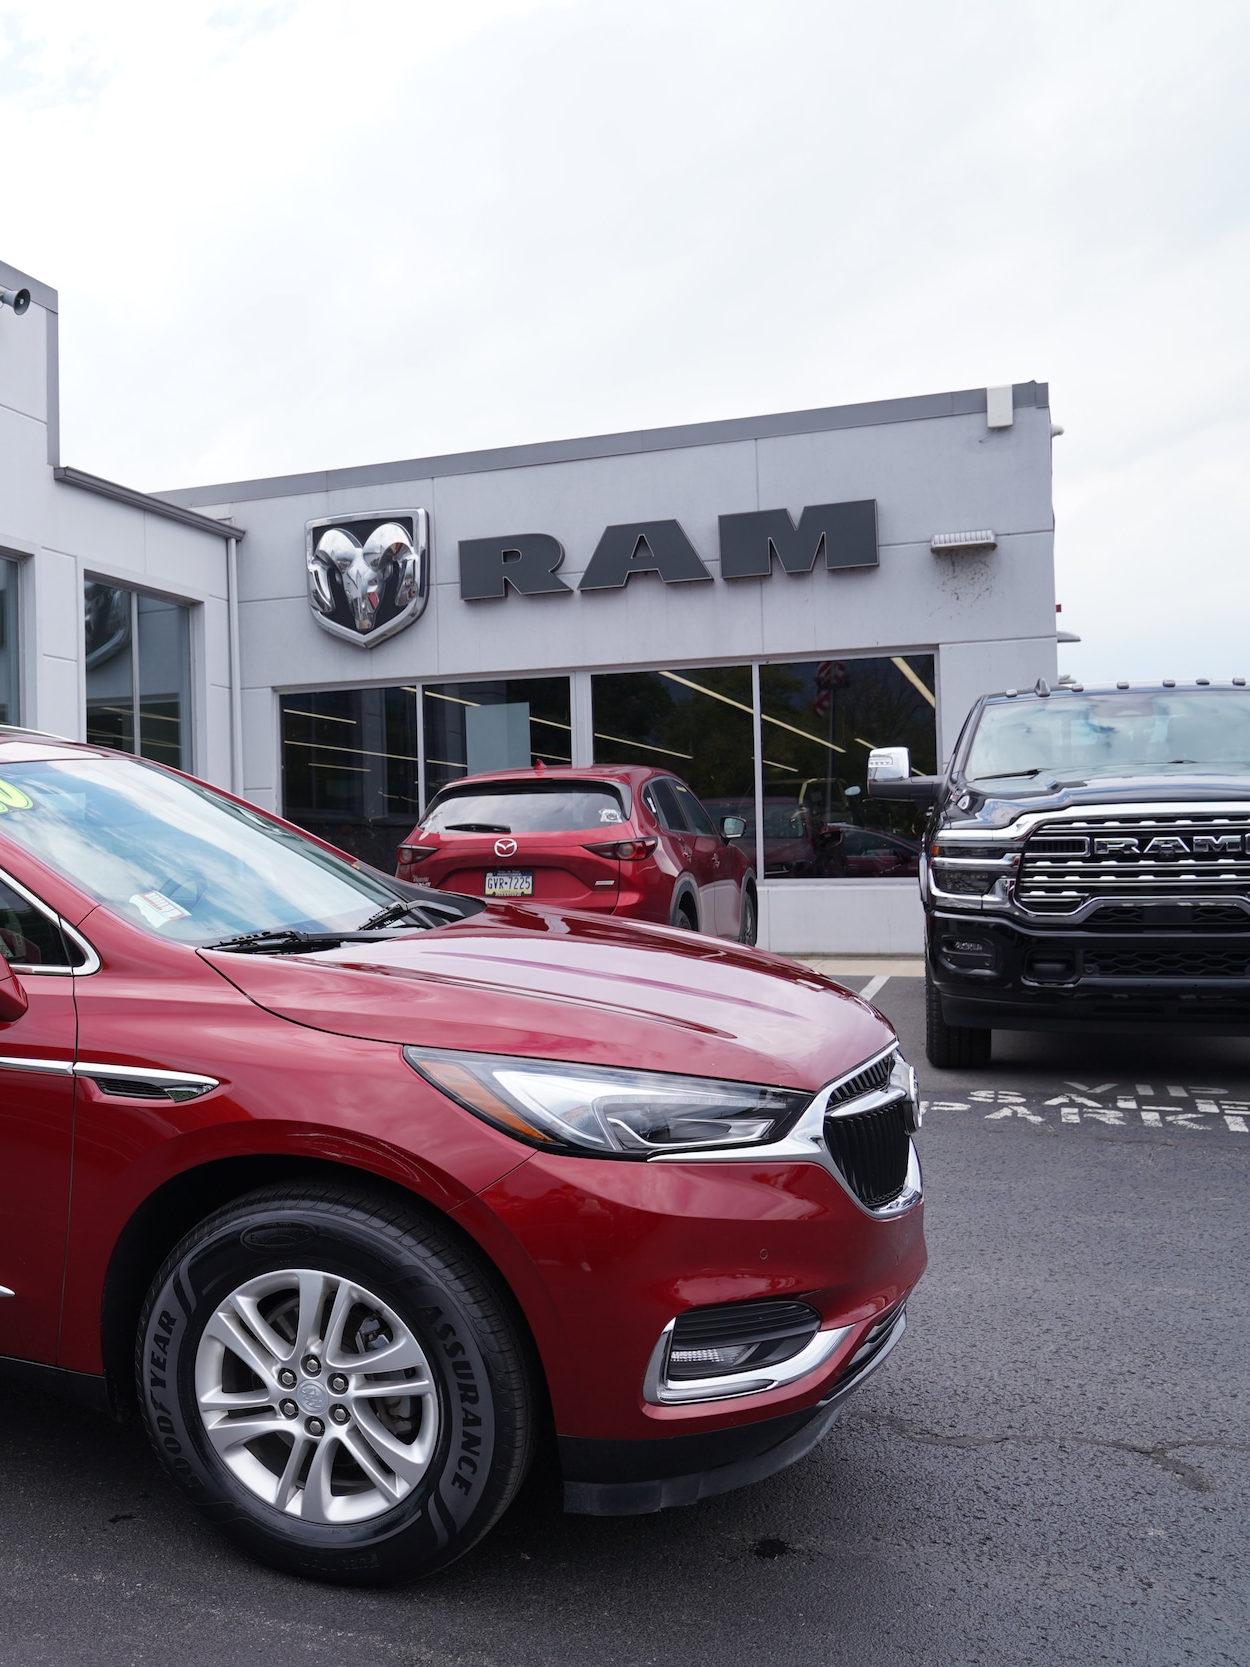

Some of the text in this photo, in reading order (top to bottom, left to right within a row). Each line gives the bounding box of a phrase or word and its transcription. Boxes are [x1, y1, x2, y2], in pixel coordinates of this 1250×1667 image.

[458, 499, 879, 601] RAM
[1094, 835, 1241, 855] RAM
[1063, 1081, 1229, 1097] VIP
[418, 1303, 482, 1497] ASSURANCE
